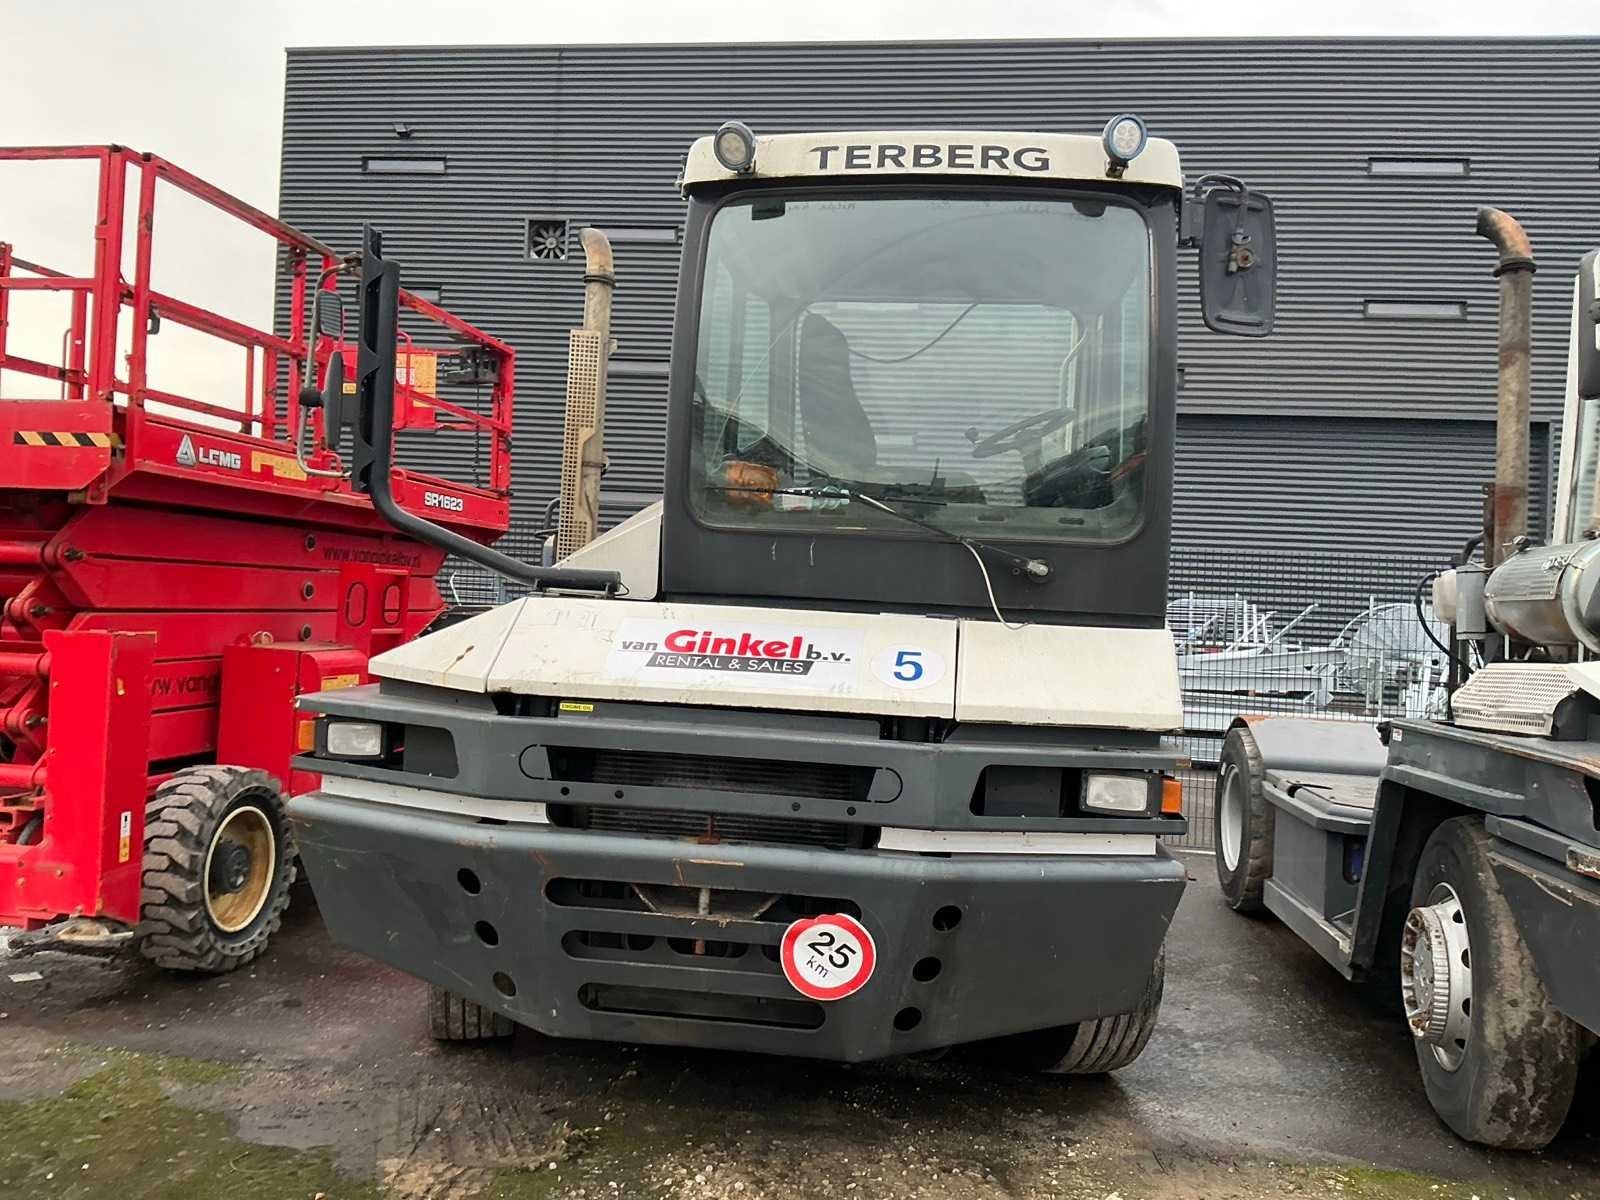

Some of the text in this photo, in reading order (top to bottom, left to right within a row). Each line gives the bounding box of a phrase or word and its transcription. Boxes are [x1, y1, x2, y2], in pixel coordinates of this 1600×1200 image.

[809, 144, 1050, 172] TERBERG
[424, 491, 464, 512] SR1623
[621, 629, 852, 662] van Ginkel b.v.
[655, 655, 805, 673] RENTAL & SALES
[893, 650, 924, 682] 5
[807, 931, 857, 969] 25
[806, 955, 830, 978] km
